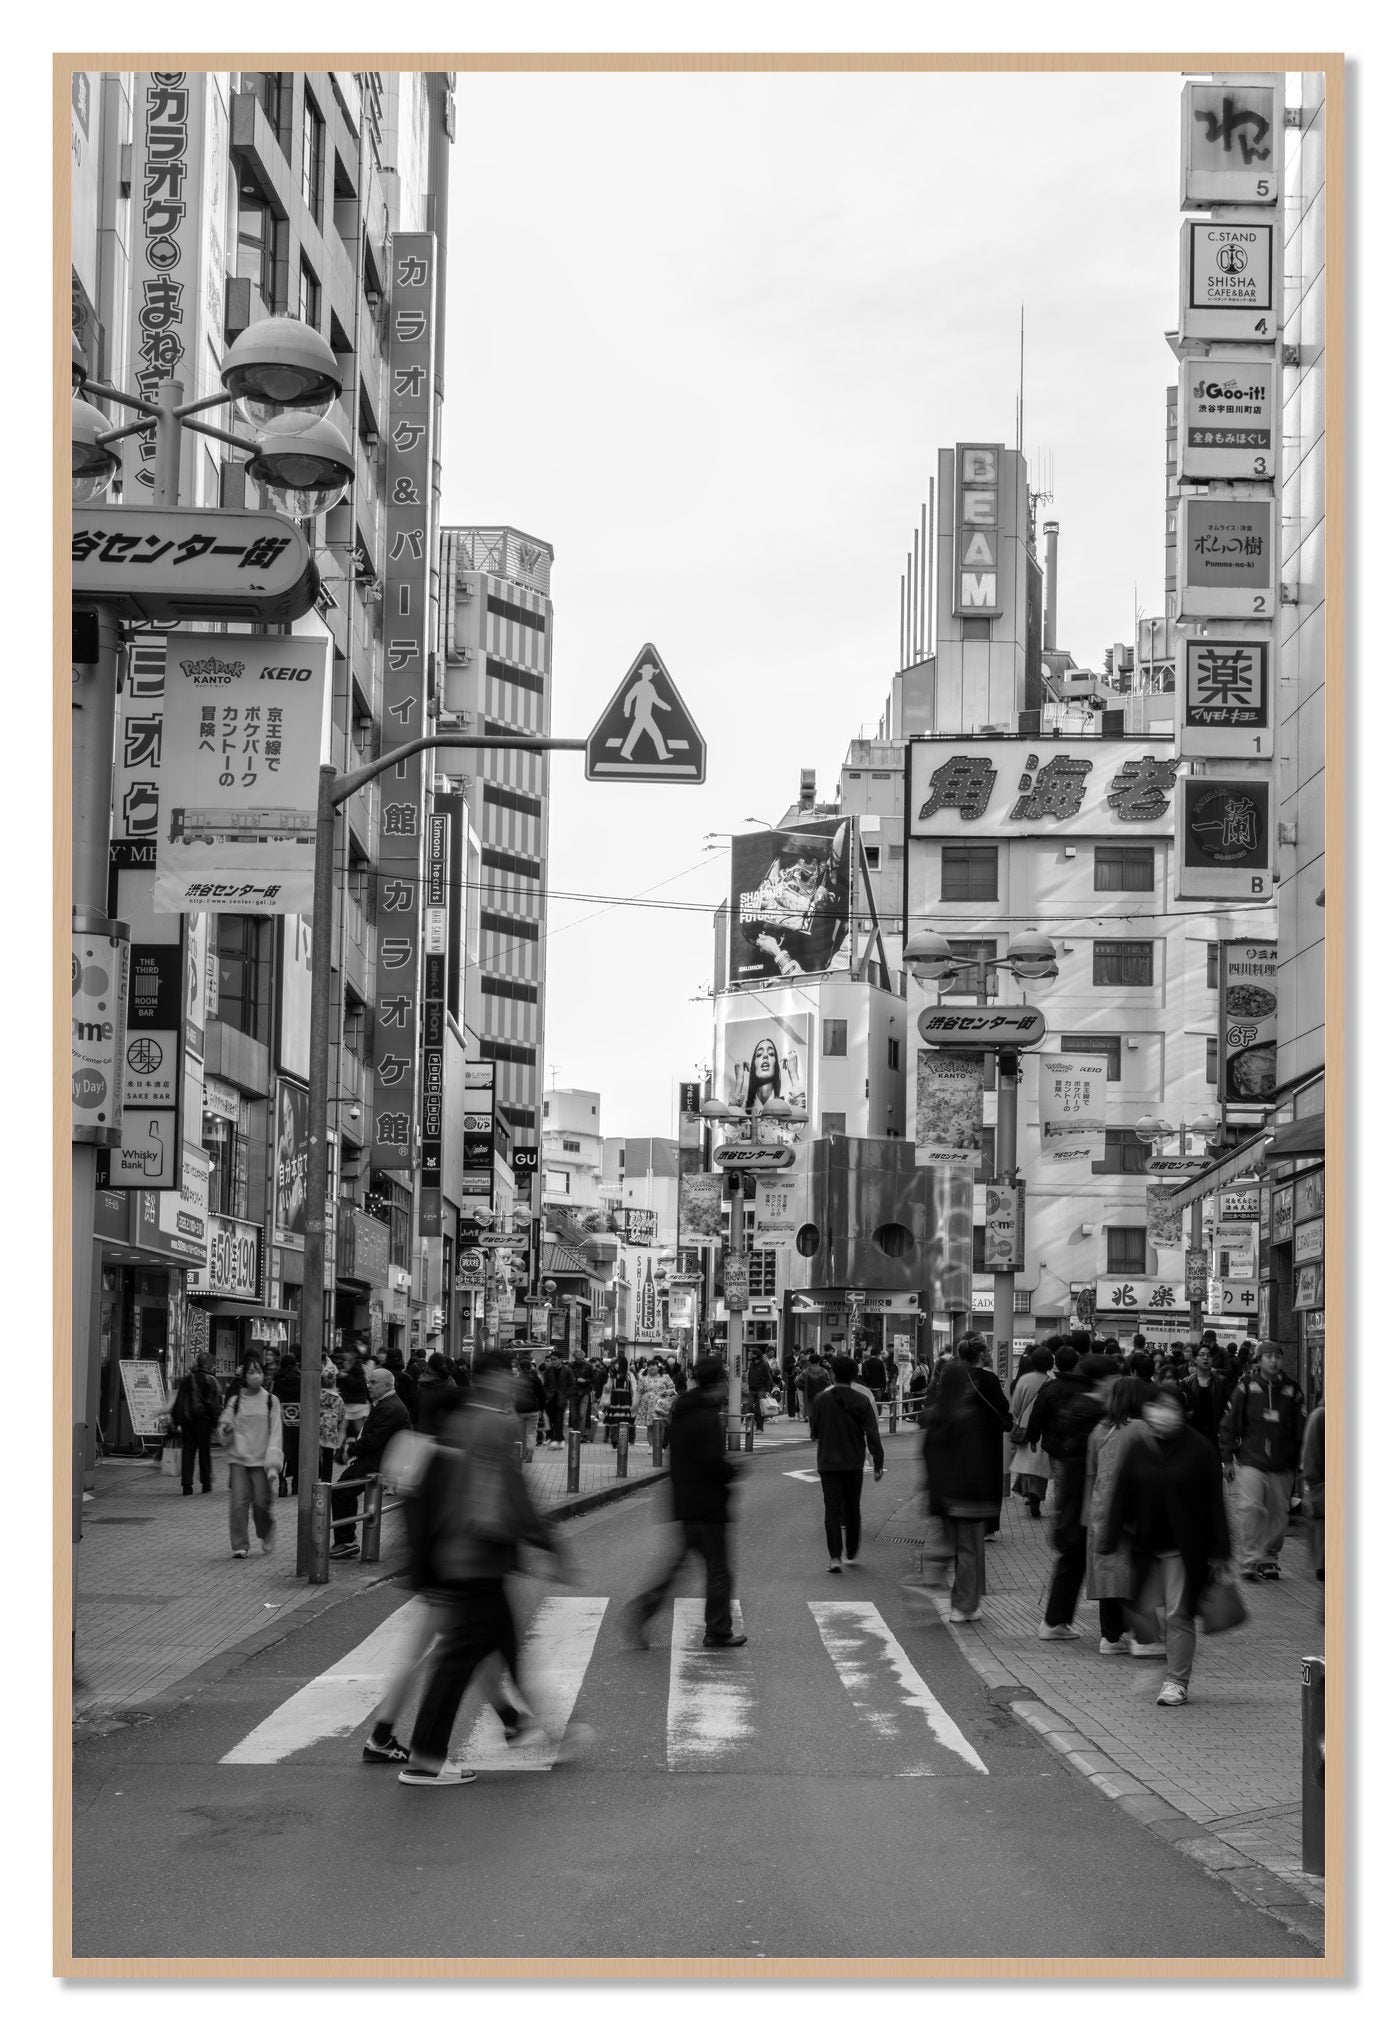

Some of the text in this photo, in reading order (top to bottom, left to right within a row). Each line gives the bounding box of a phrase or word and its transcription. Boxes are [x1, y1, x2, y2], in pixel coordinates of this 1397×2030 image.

[145, 87, 189, 239] カラオケ
[1256, 180, 1269, 196] 5
[1208, 232, 1257, 242] C.STAND
[1208, 277, 1256, 288] SHISHA
[1208, 288, 1256, 297] CAFE&BAR
[1255, 318, 1267, 334] 4
[1206, 383, 1265, 400] Goo-it!
[1199, 405, 1261, 414] 渋谷宇田川町店
[1193, 432, 1266, 445] 全身もみほぐし
[1254, 457, 1267, 474] 3
[961, 449, 997, 606] BEAM
[1194, 535, 1263, 556] ポムの樹
[1205, 560, 1254, 569] Pomme-no-ki
[1253, 596, 1266, 613] 2
[193, 676, 232, 684] KANTO
[259, 667, 312, 682] KEIO
[1197, 649, 1252, 704] 薬
[1191, 707, 1258, 723] マツモトキヨシ
[199, 705, 216, 753] 冒険へ
[218, 706, 239, 787] カントーの
[241, 706, 261, 787] ポケパーク
[265, 706, 283, 772] 京王線で
[1252, 736, 1262, 752] 1
[919, 754, 1182, 821] 角海老
[1191, 797, 1257, 849] 一蘭
[433, 820, 442, 901] kimono hearts
[185, 883, 282, 898] 渋谷センター街
[1251, 876, 1264, 894] B
[740, 888, 783, 904] SHAPING
[136, 966, 159, 974] THIRD
[738, 964, 764, 972] SALOMON
[1229, 963, 1277, 976] 四川料理
[135, 997, 159, 1005] ROOM
[926, 1016, 1038, 1031] 渋谷センター街
[1227, 1026, 1258, 1047] 6F
[83, 1079, 104, 1093] Day!
[477, 1121, 490, 1130] UP
[122, 1149, 158, 1162] Whisky
[515, 1153, 537, 1165] GU
[718, 1151, 785, 1160] 渋谷センター街
[121, 1160, 143, 1169] Bank
[644, 1282, 655, 1329] BEER
[642, 1330, 656, 1338] HALL
